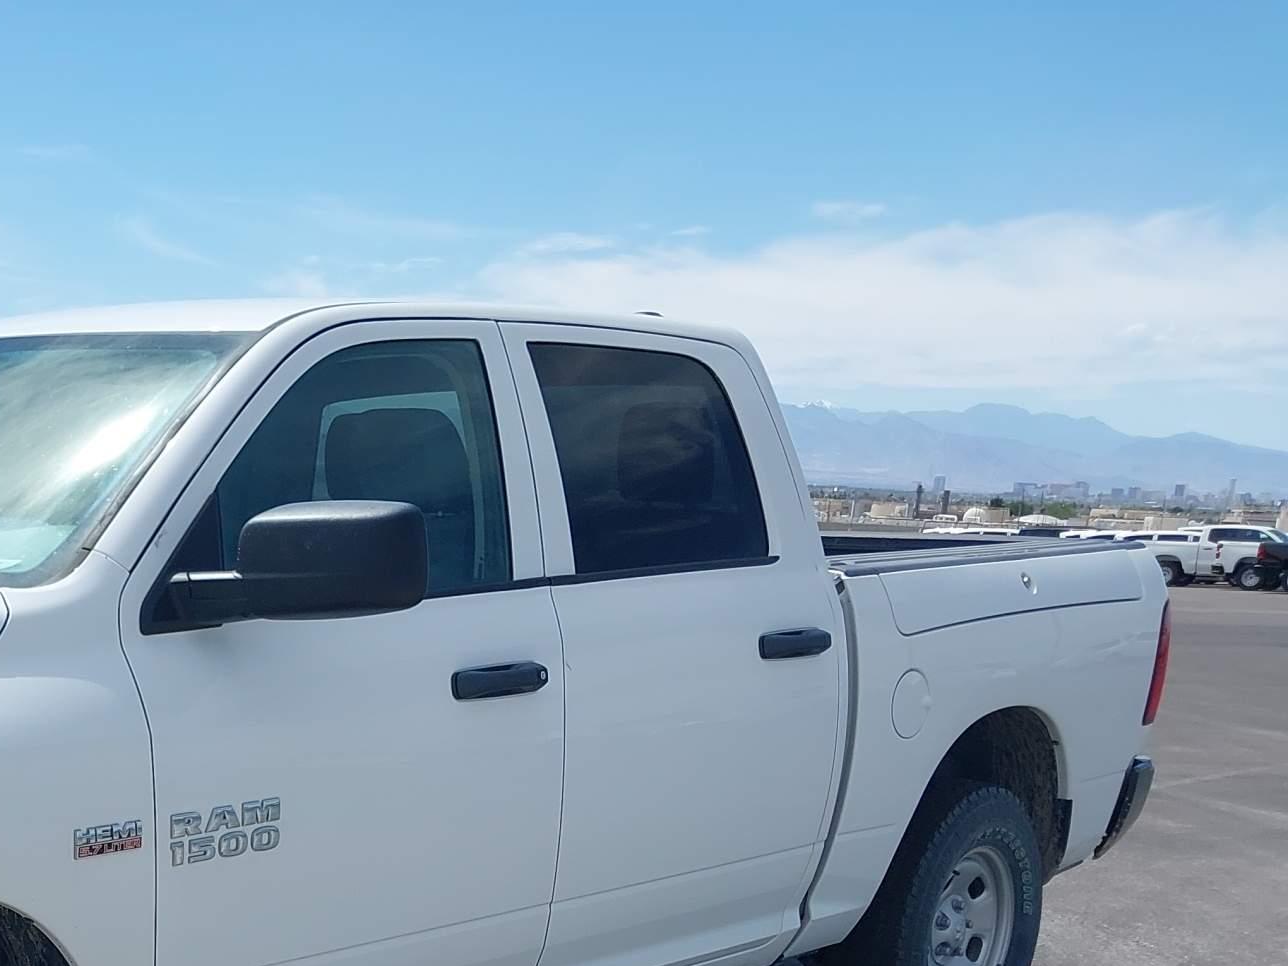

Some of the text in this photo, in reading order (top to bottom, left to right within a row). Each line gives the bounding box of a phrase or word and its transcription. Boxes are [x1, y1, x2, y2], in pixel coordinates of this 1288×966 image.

[73, 820, 142, 846] HEMI
[170, 797, 281, 839] RAM
[79, 837, 142, 858] 5.7 LITER
[170, 825, 280, 867] 1500
